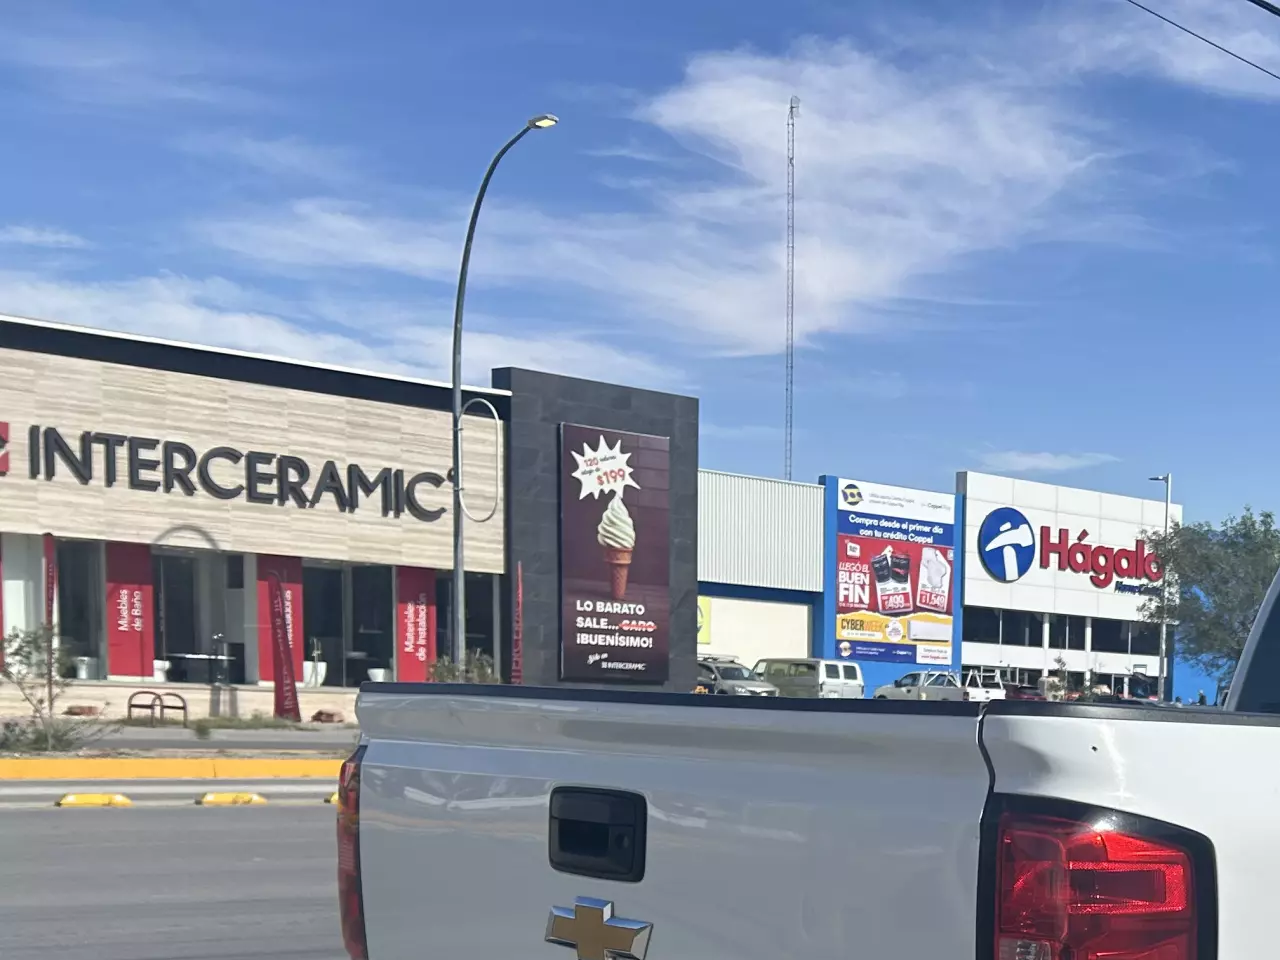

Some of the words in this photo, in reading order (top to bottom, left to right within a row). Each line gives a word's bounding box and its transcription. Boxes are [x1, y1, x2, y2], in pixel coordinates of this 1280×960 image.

[28, 424, 448, 522] INTERCERAMIC
[597, 468, 625, 485] $199
[848, 514, 879, 527] Compra
[879, 518, 901, 529] desde
[901, 521, 908, 530] el
[859, 528, 873, 537] con
[874, 530, 882, 538] tu
[908, 534, 934, 545] Coppel
[1040, 525, 1164, 589] Hágalo
[839, 570, 870, 585] BUEN
[839, 583, 870, 605] FIN
[117, 589, 130, 631] Muebles
[576, 600, 593, 612] LO
[596, 601, 645, 615] BARATO
[576, 616, 619, 630] SALE...
[576, 632, 653, 648] ¡BUENÍSIMO!
